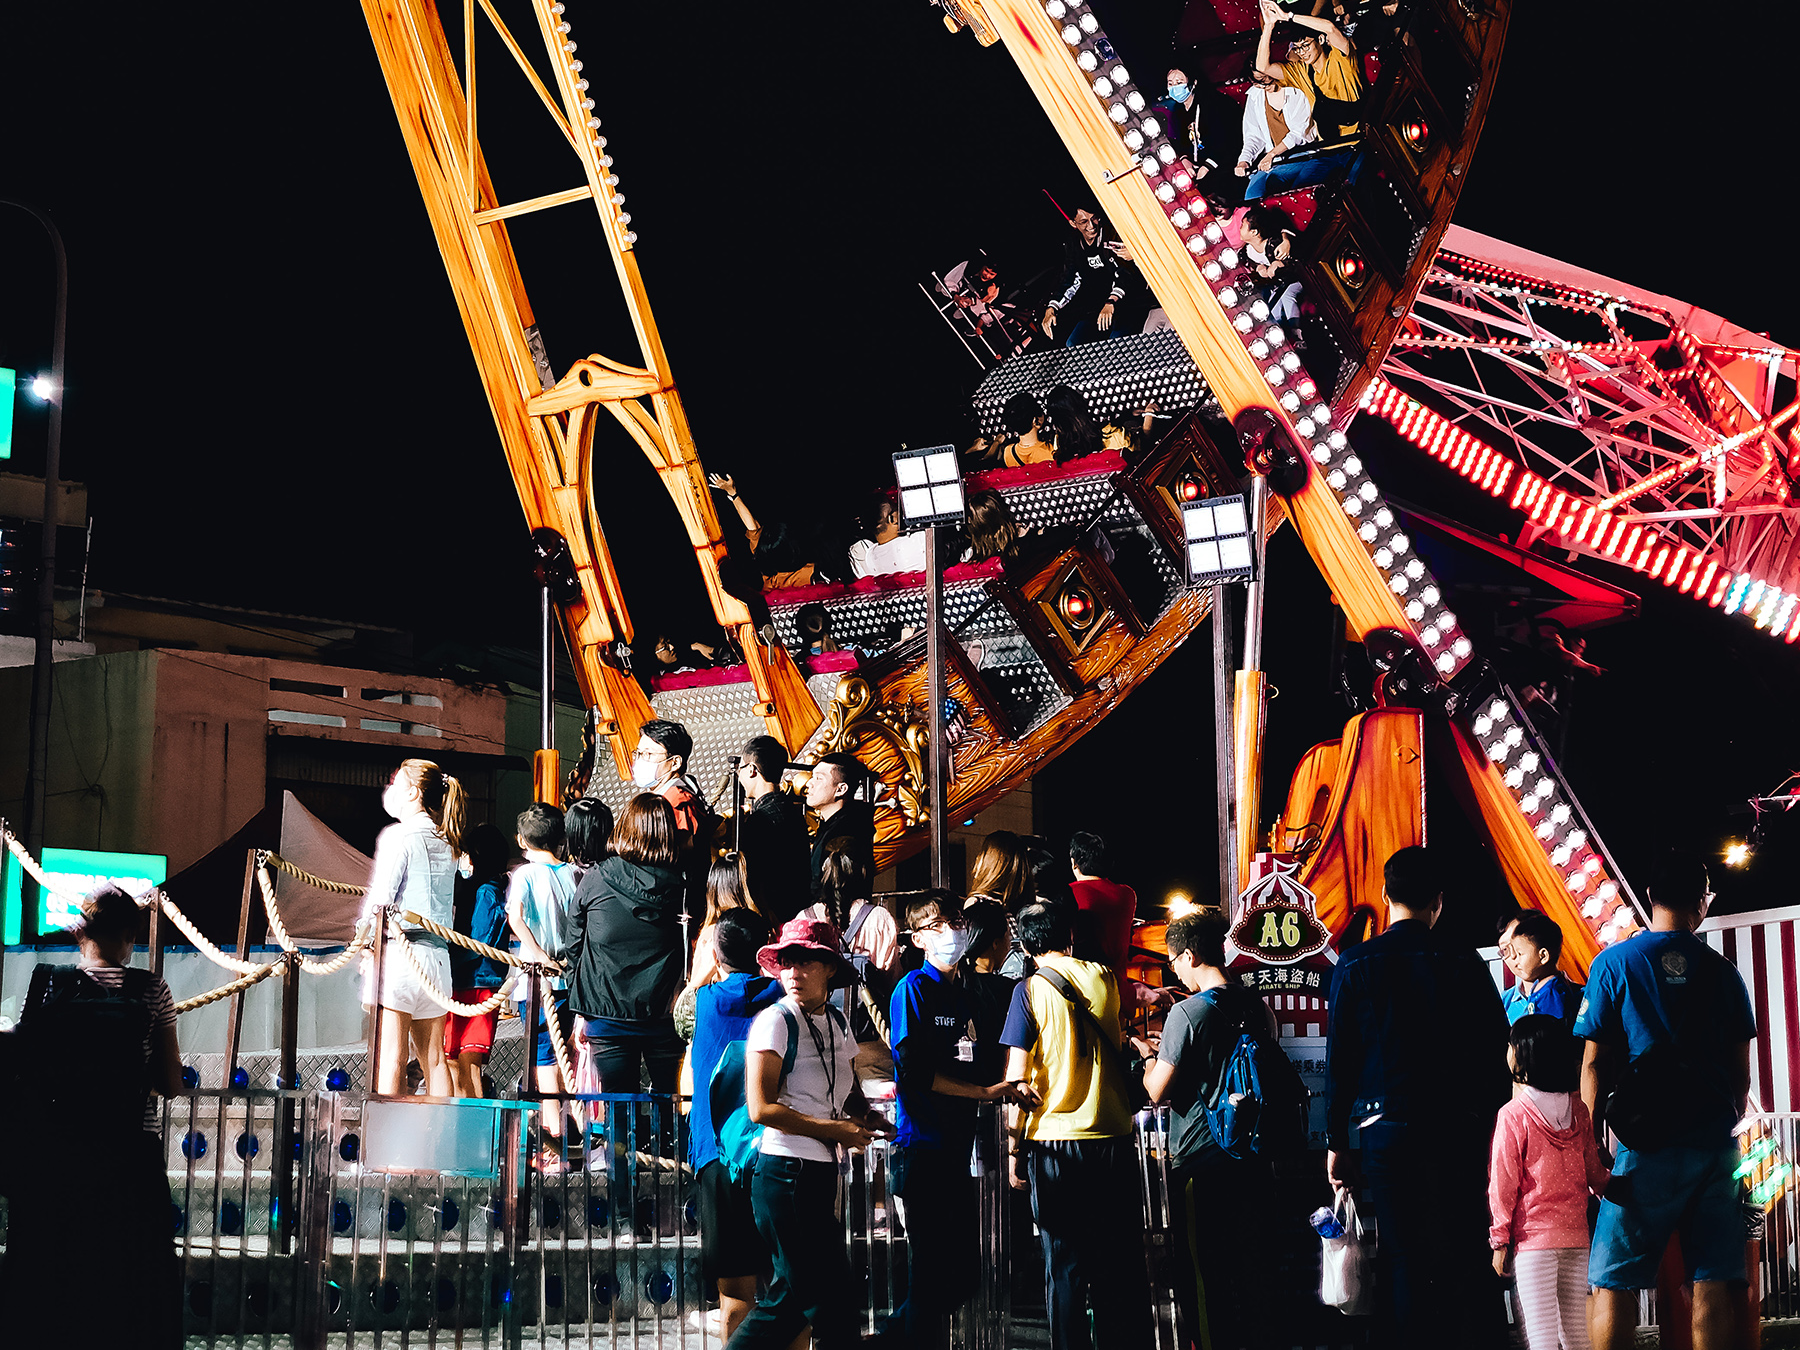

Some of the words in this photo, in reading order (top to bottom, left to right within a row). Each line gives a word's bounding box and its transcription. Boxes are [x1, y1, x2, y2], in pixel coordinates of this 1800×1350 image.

[1258, 911, 1300, 947] A6
[1240, 968, 1320, 988] 擎天海盜船
[1258, 983, 1282, 991] PIRATE
